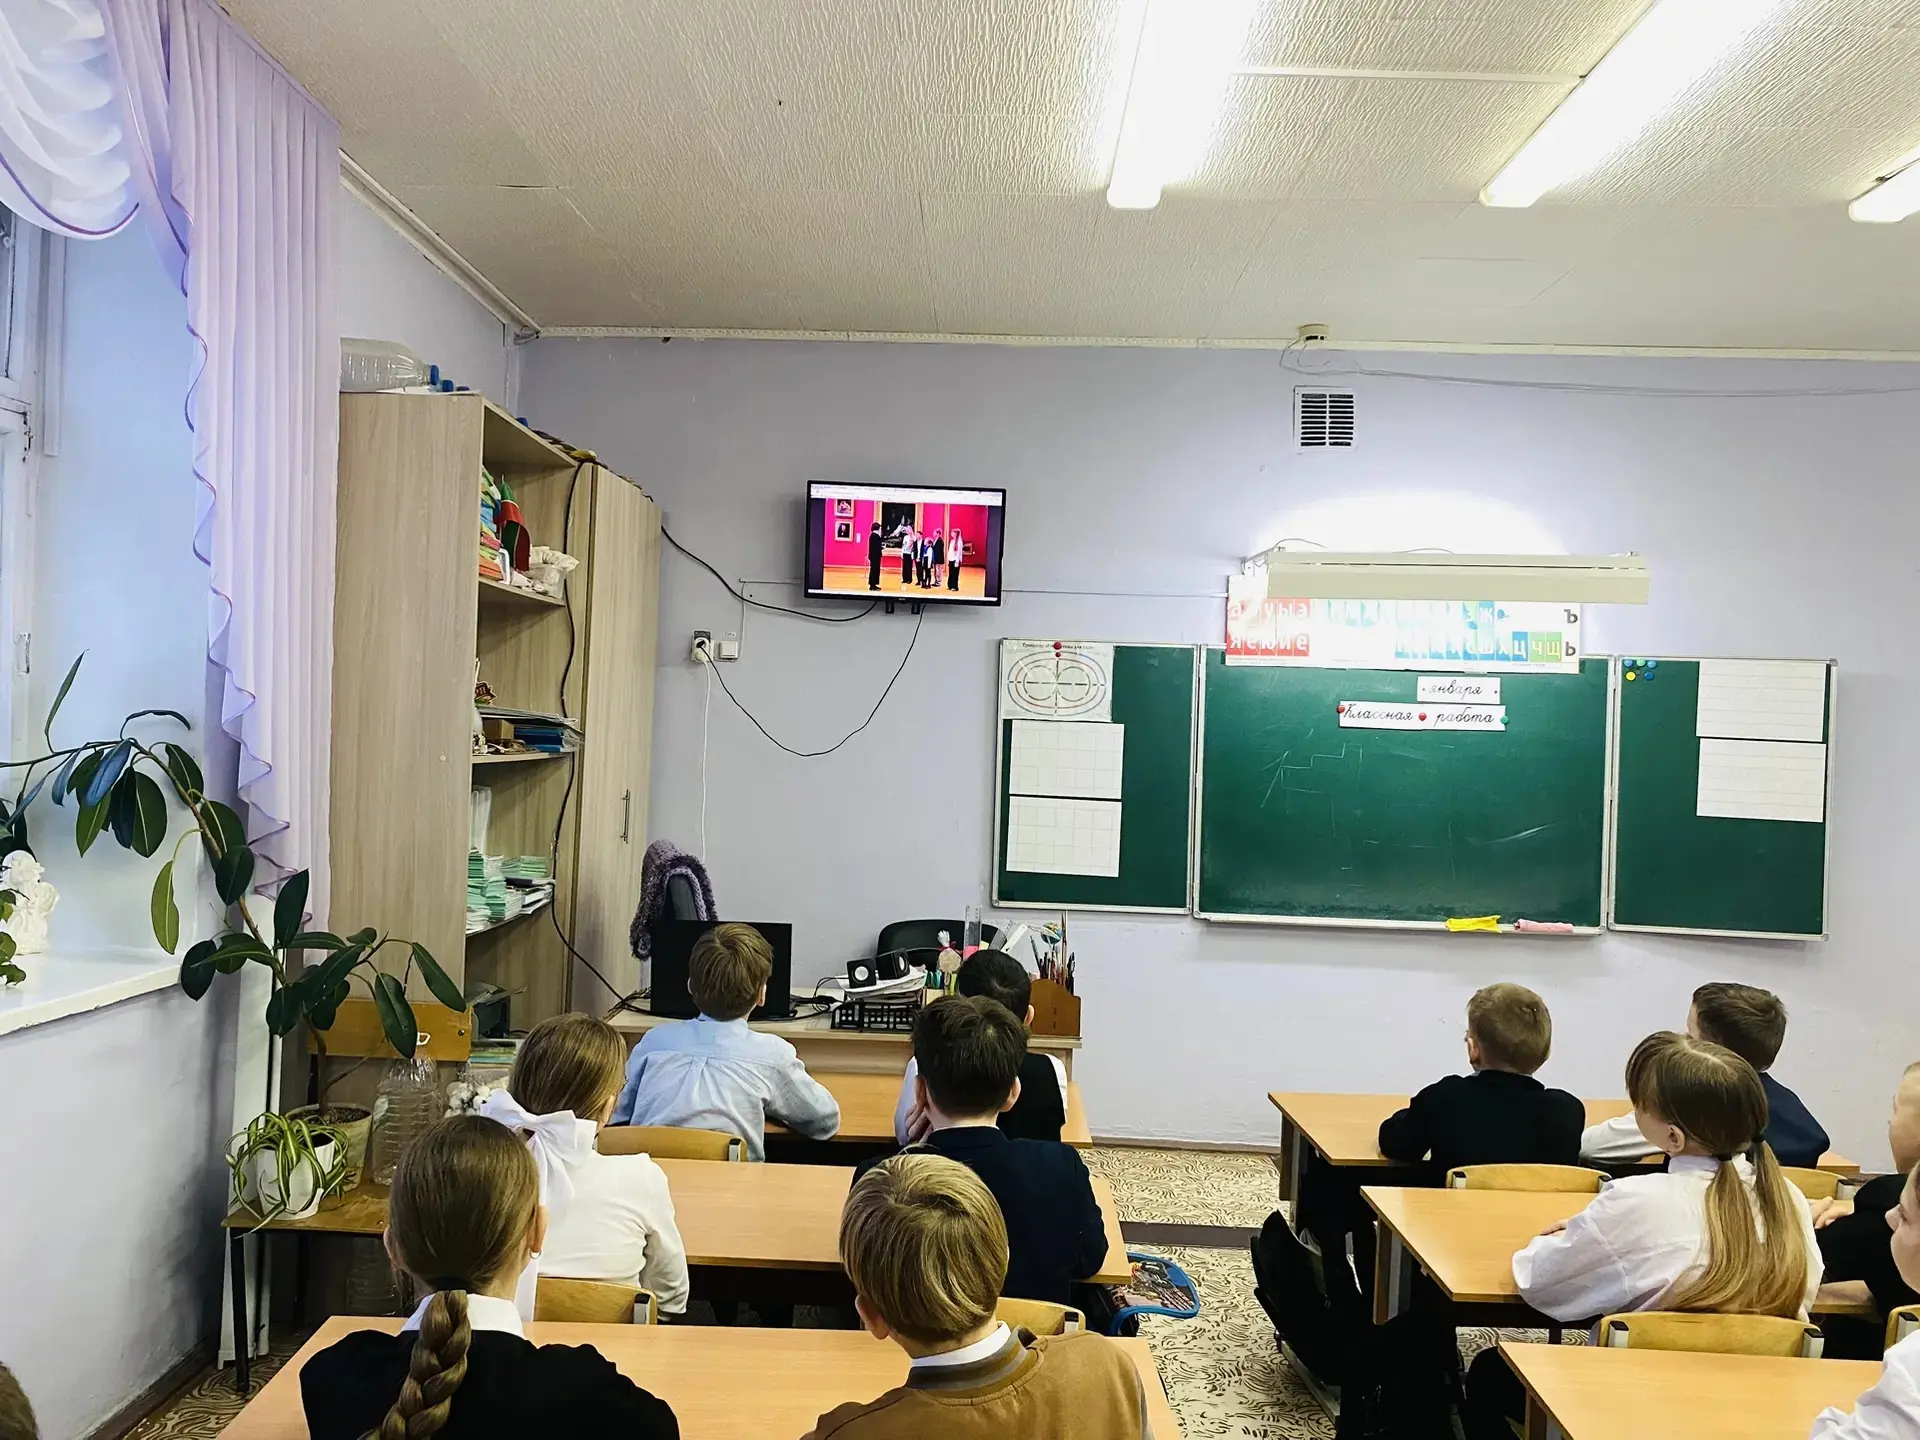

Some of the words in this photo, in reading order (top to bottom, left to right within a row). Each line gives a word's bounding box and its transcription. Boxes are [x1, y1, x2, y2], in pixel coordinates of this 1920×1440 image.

[1429, 679, 1483, 701] января
[1343, 703, 1413, 721] Классная
[1434, 706, 1494, 728] работа
